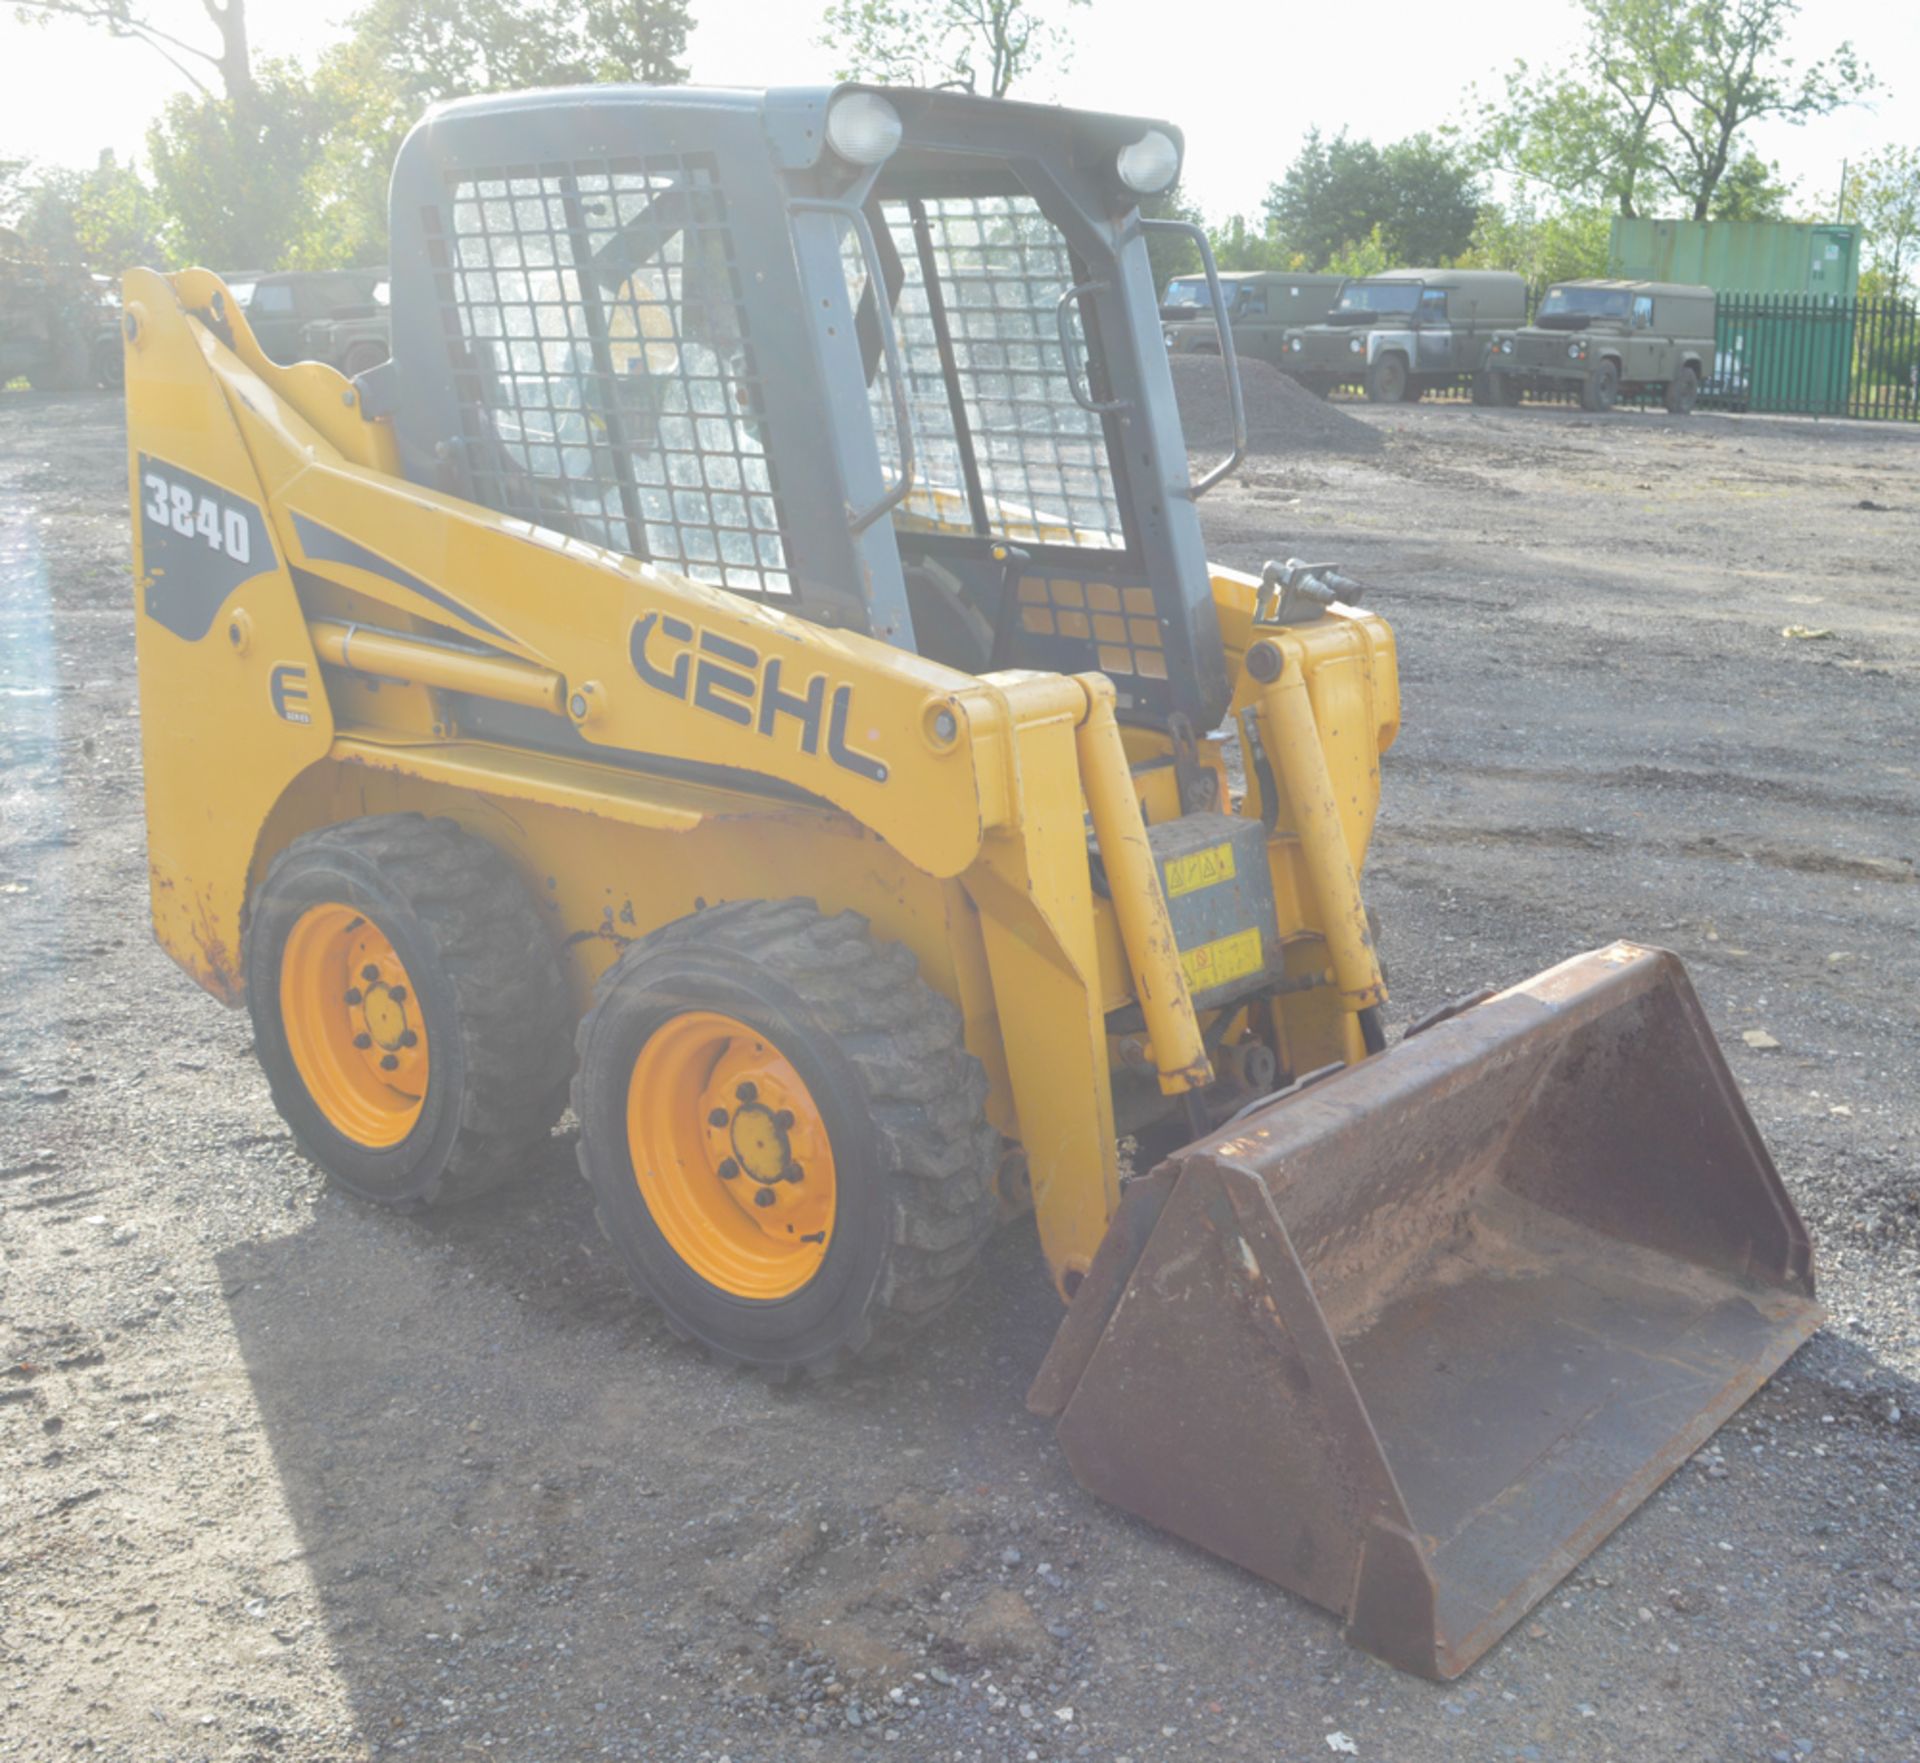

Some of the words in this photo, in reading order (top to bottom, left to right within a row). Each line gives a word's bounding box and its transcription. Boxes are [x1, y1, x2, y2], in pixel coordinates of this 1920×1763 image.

[144, 474, 250, 564] 3840
[270, 666, 311, 724] E
[629, 611, 888, 783] GEHL
